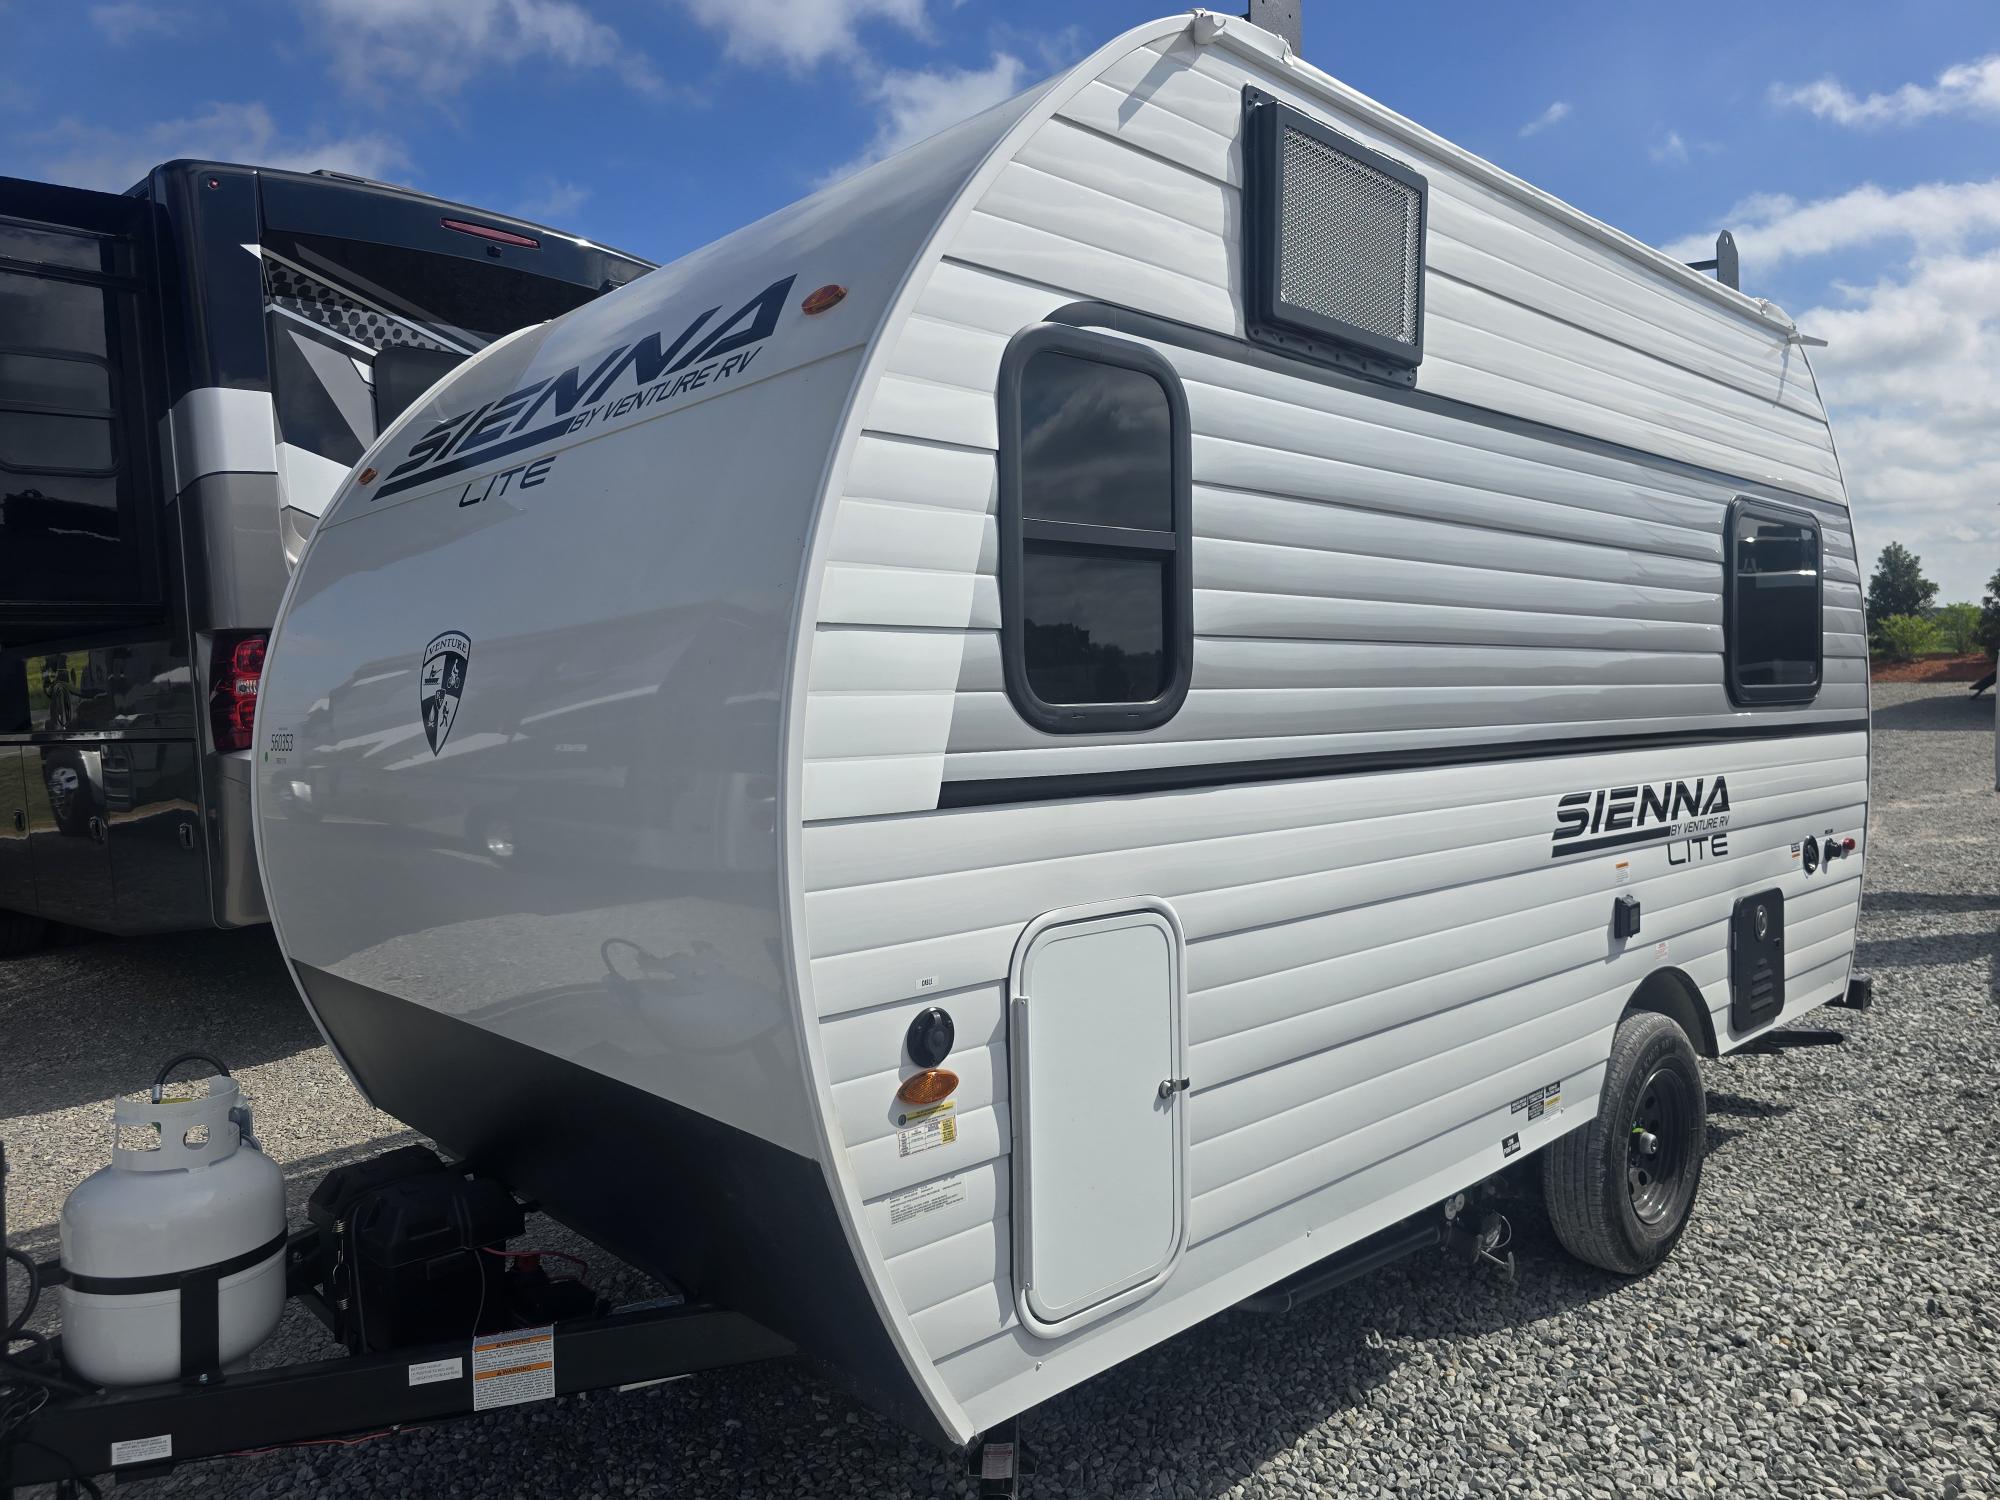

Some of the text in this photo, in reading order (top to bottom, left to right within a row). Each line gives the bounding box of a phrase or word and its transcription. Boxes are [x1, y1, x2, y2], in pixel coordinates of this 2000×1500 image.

[384, 273, 798, 481] SIENNA
[567, 346, 763, 434] BY VENTURE RV
[458, 456, 557, 508] LITE
[429, 639, 467, 654] VENTURE
[271, 733, 294, 752] 560353
[1552, 776, 1730, 841] SIENNA
[1671, 815, 1730, 836] BY VENTURE RV
[1667, 833, 1729, 866] LITE
[502, 1365, 532, 1375] WARNING
